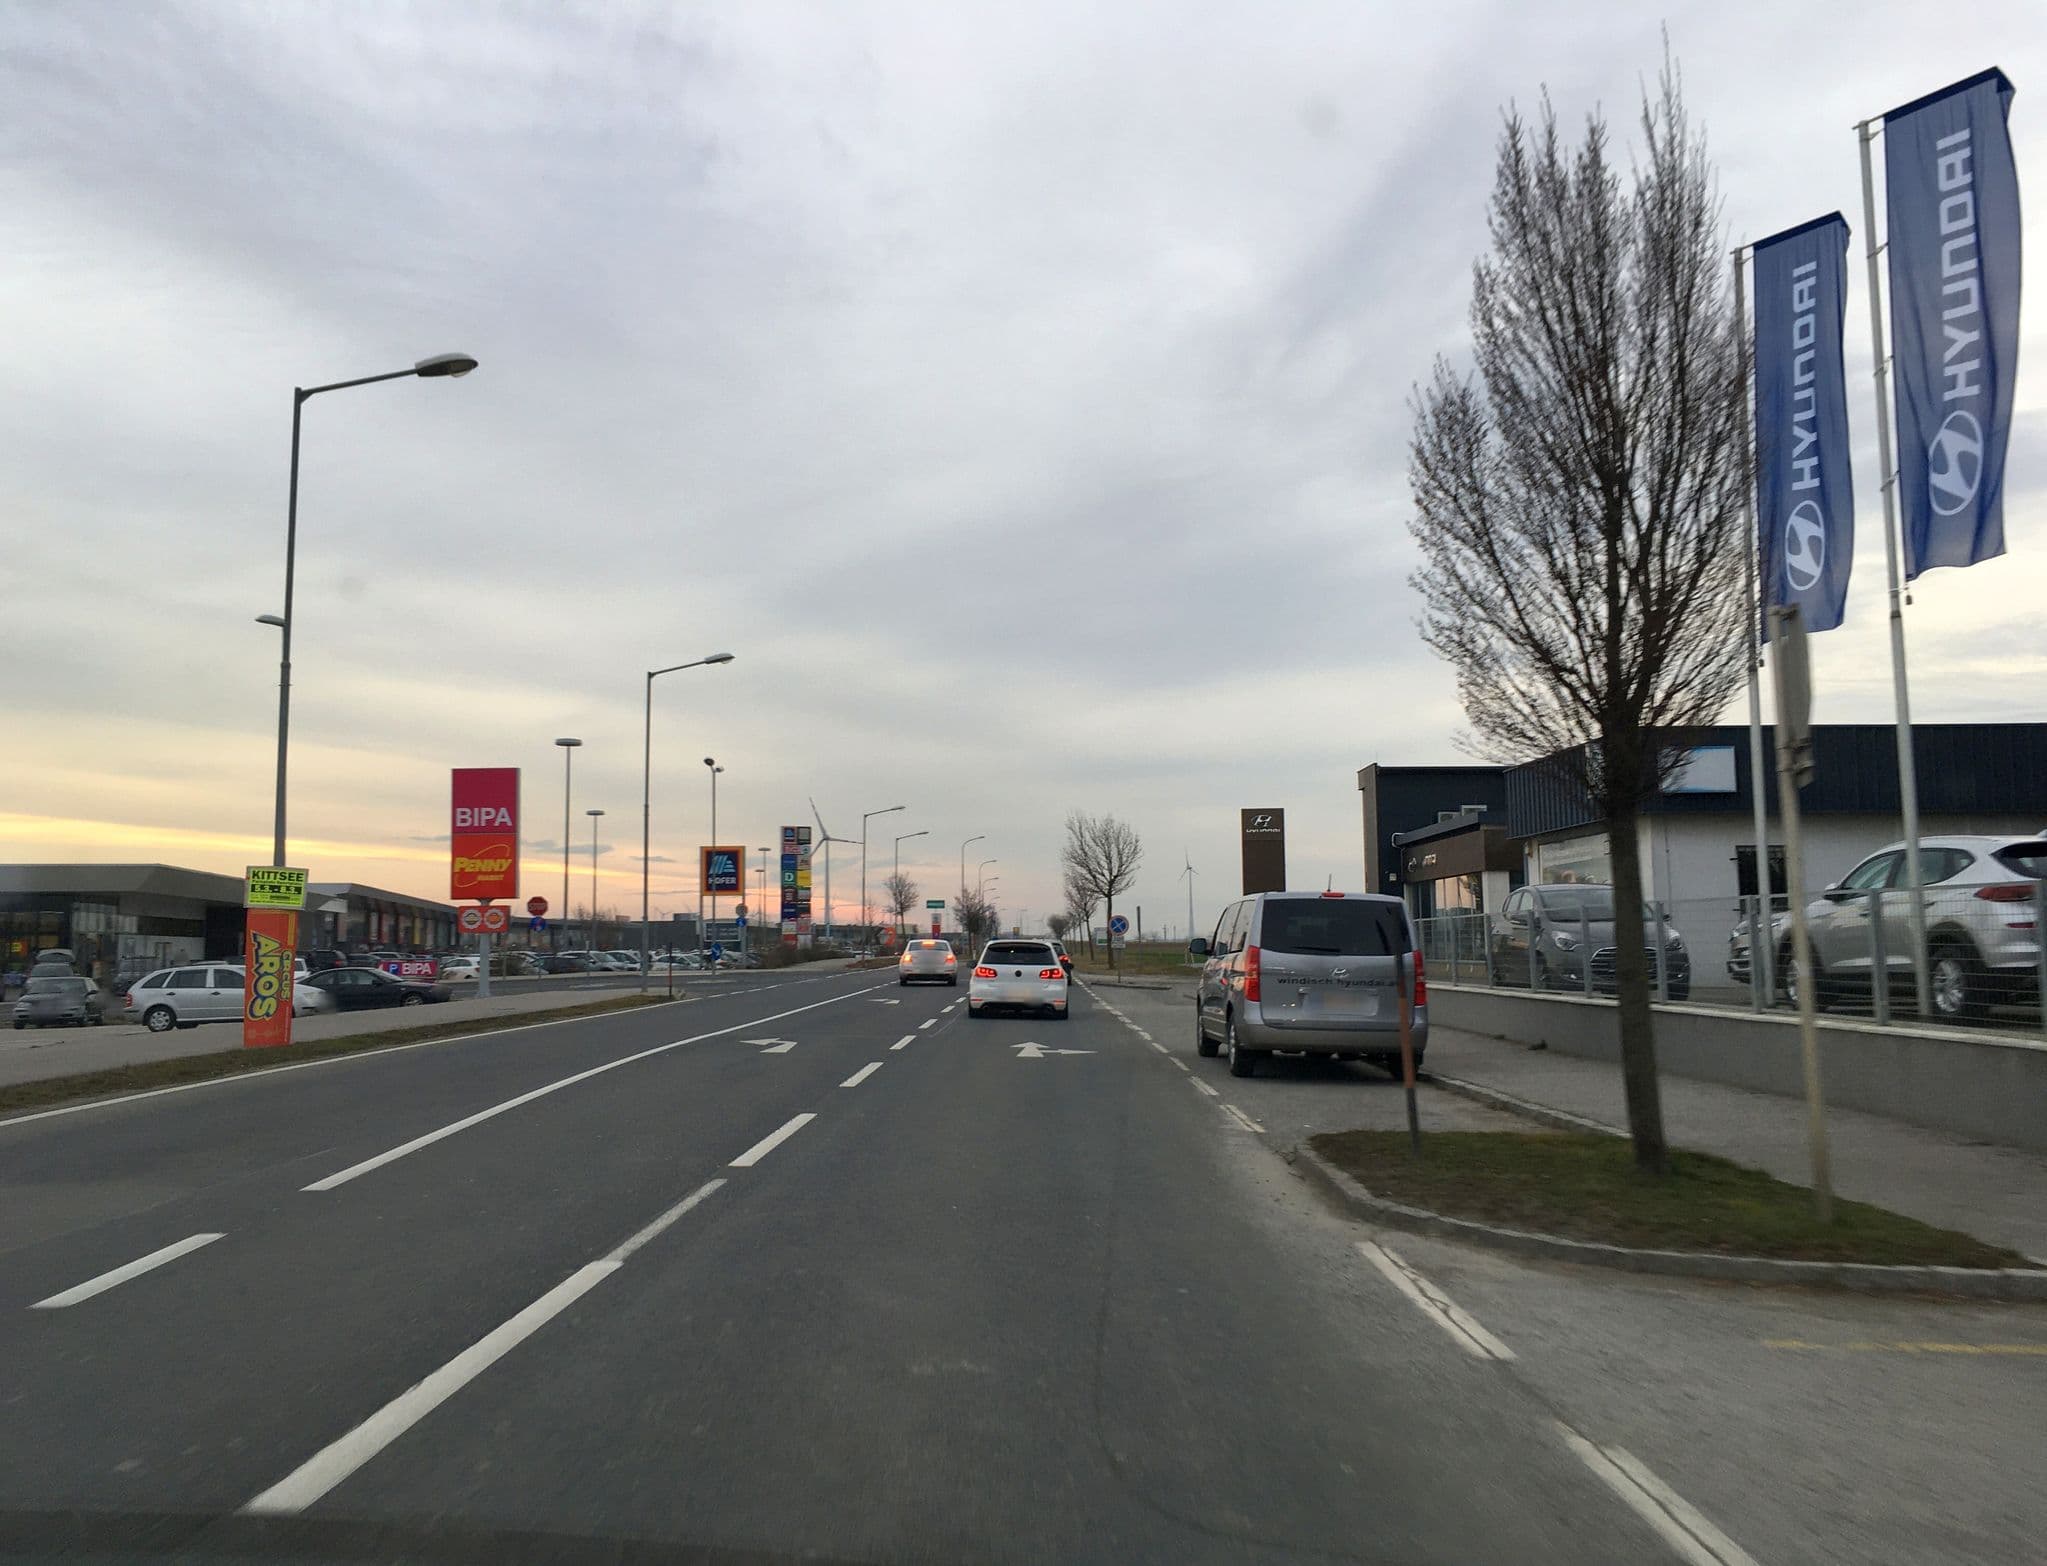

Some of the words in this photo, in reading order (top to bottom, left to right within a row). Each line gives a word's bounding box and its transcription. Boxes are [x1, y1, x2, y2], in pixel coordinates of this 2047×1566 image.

[1935, 127, 1981, 402] HYUNDAI
[1791, 260, 1821, 491] HYUNDAI
[455, 807, 513, 827] BIPA
[453, 857, 513, 872] PENNY
[251, 870, 304, 882] KITTSEE
[247, 931, 282, 1021] AROS
[401, 962, 433, 975] BIPA
[1277, 976, 1334, 986] windisch
